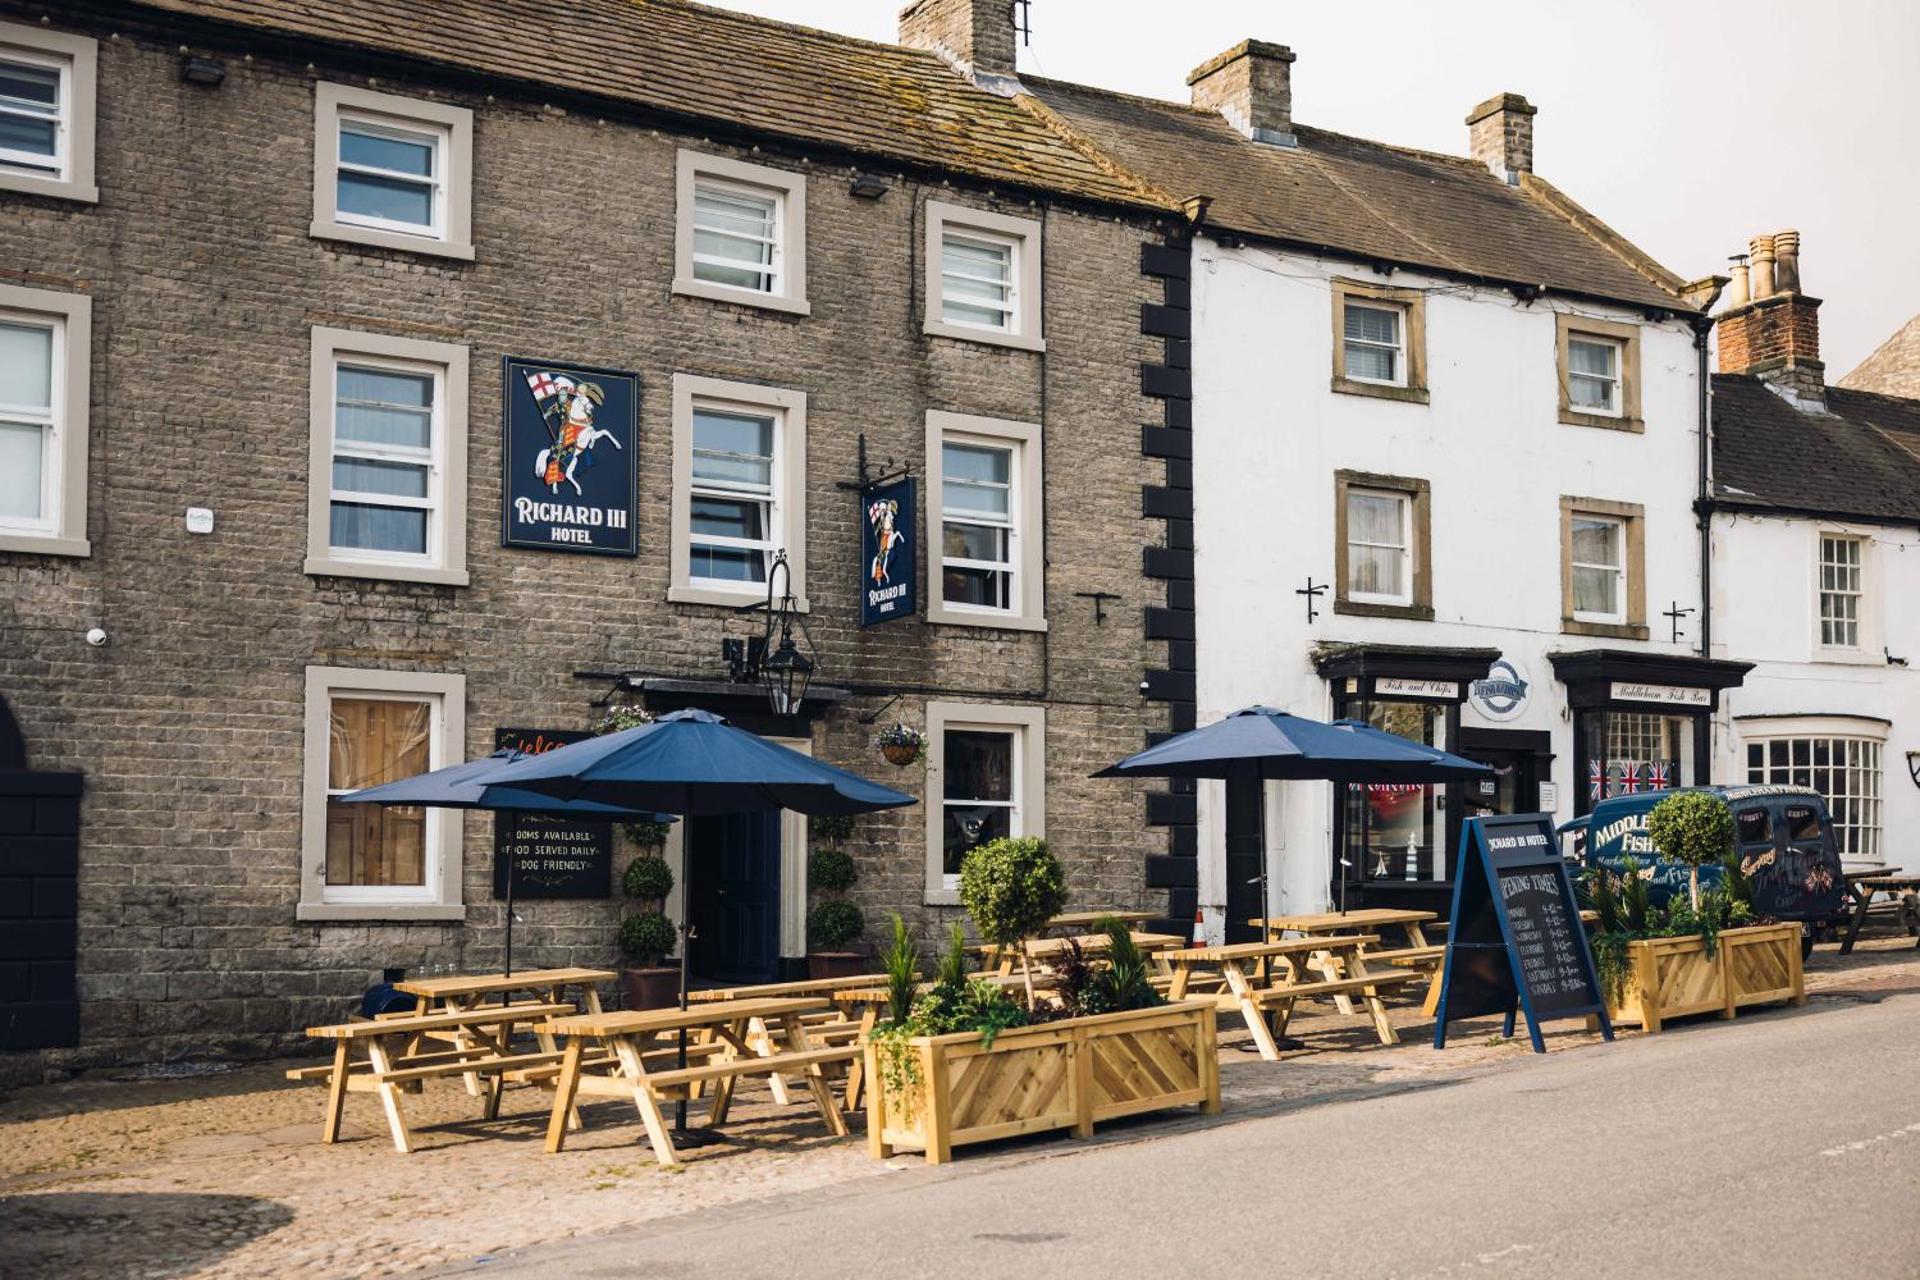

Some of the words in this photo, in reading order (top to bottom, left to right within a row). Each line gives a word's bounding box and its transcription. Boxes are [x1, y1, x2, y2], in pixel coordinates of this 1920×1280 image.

[514, 496, 603, 525] RICHARD
[606, 508, 627, 529] III
[551, 527, 592, 543] HOTEL
[869, 586, 897, 606] RICHARD
[880, 602, 894, 612] HOTEL
[1384, 679, 1403, 691] Fish
[1408, 680, 1426, 692] and
[1429, 681, 1451, 696] Chips
[515, 831, 539, 840] OOMS
[543, 831, 591, 841] AVAILABLE
[1526, 833, 1549, 847] HOTEL
[505, 845, 530, 855] FOD
[535, 845, 568, 855] SERVED
[571, 846, 596, 856] DAILY
[521, 860, 539, 870] DOG
[543, 860, 587, 870] FRIENDLY
[1530, 873, 1560, 896] TIMES
